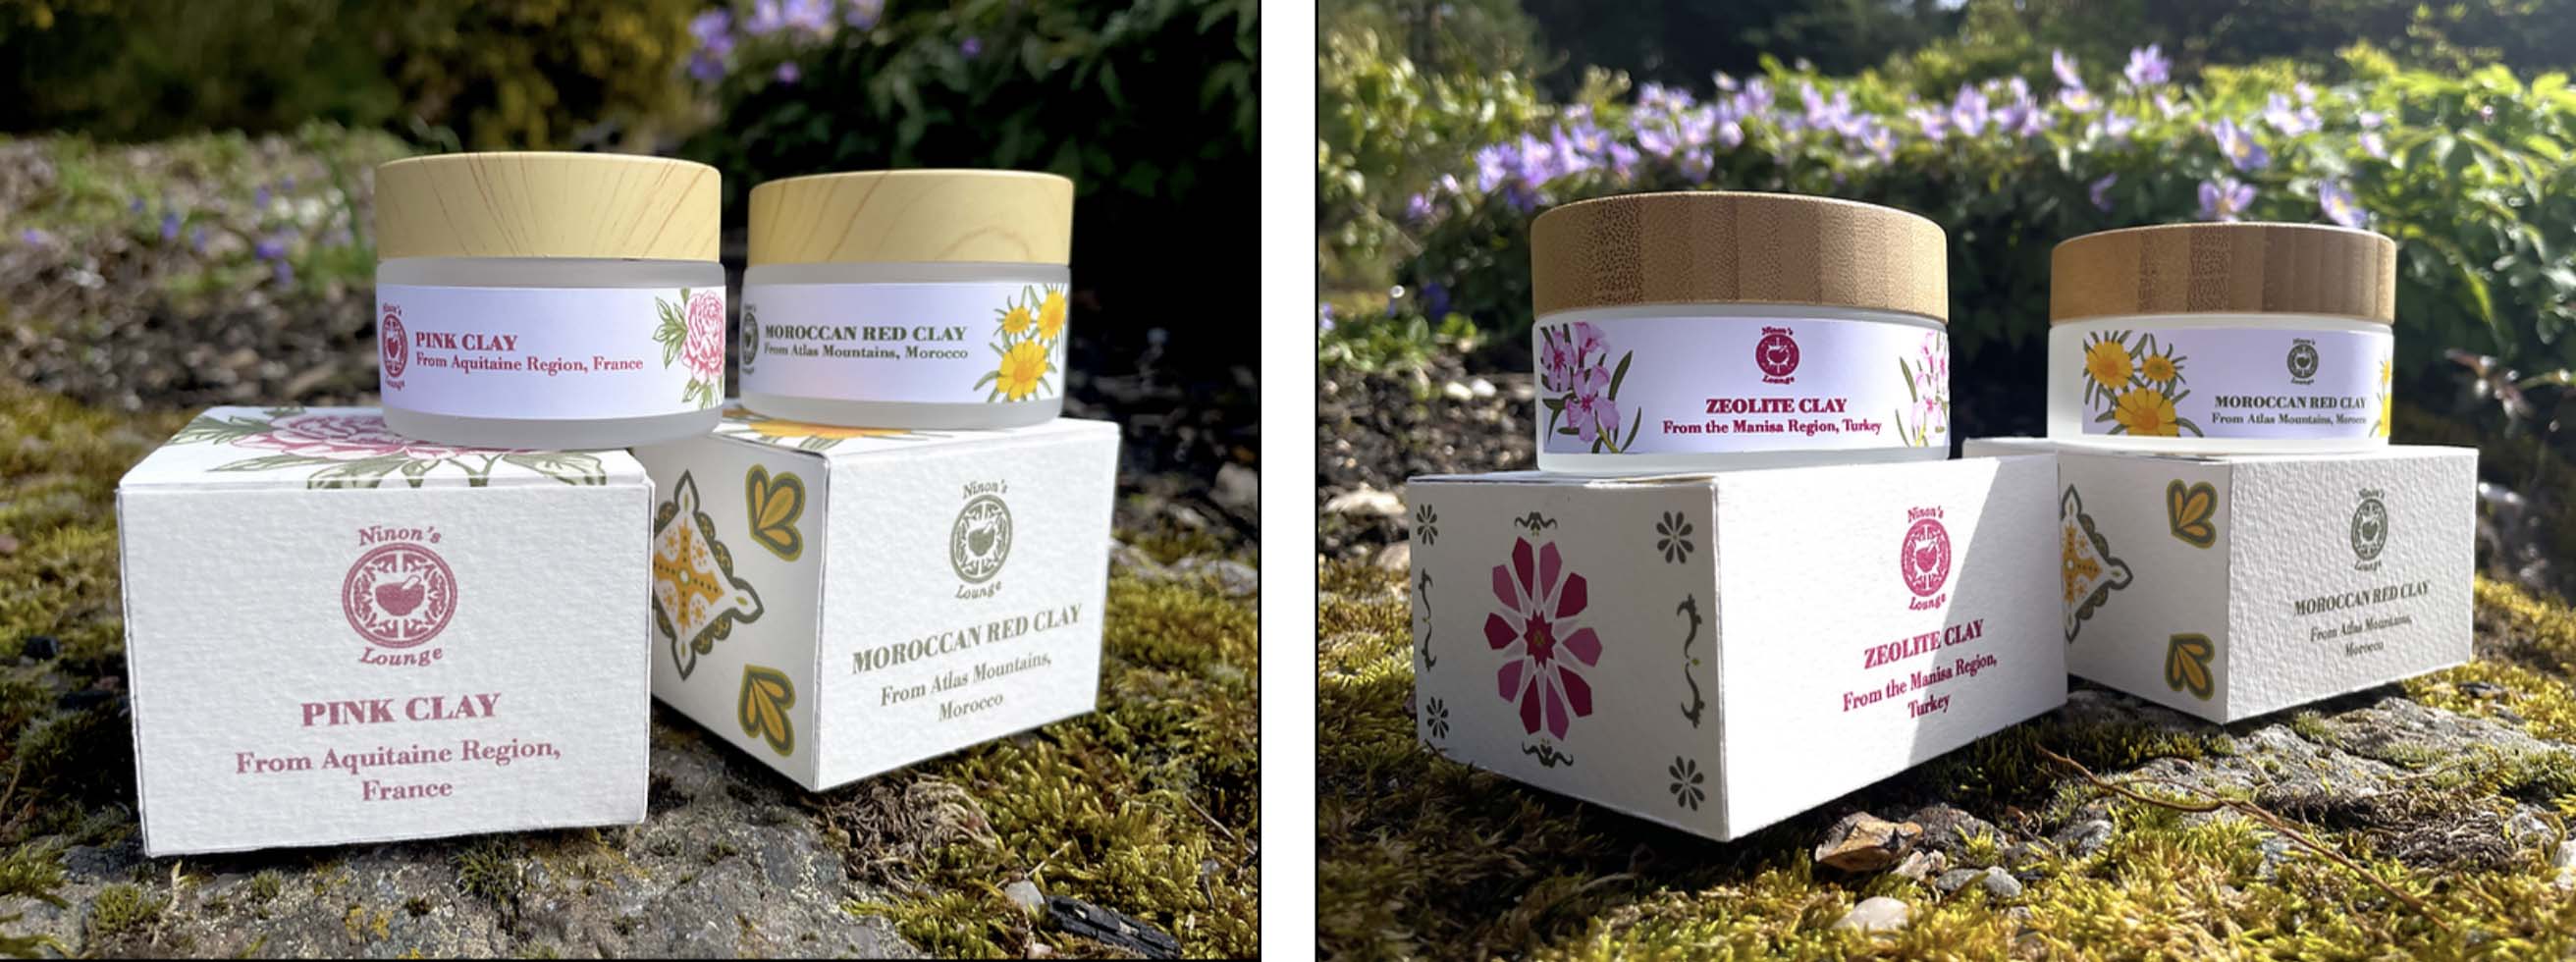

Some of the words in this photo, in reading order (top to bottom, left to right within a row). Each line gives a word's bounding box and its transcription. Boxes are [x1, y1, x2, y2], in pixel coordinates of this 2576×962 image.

[416, 332, 457, 349] PINK
[461, 333, 518, 351] CLAY
[765, 325, 857, 341] MOROCCAN
[863, 326, 907, 342] RED
[913, 326, 967, 342] CLAY
[764, 344, 788, 356] From
[792, 345, 818, 356] Atlas
[823, 346, 900, 360] Mountains,
[905, 347, 968, 359] Morocco
[416, 351, 448, 368] From
[452, 354, 522, 374] Aquitaine
[527, 356, 588, 376] Region,
[592, 355, 643, 371] France
[1706, 398, 1795, 414] ZEOLITE
[1798, 398, 1848, 413] CLAY
[2215, 396, 2306, 409] MOROCCAN
[2309, 396, 2337, 409] RED
[2339, 396, 2366, 409] CLAY
[1663, 420, 1702, 434] From
[1705, 419, 1729, 434] the
[1733, 419, 1784, 433] Manisa
[1788, 419, 1840, 437] Region,
[1842, 418, 1882, 436] Turkey
[2212, 412, 2244, 424] From
[2248, 412, 2275, 424] Atlas
[2278, 413, 2333, 425] Mountains,
[962, 479, 1008, 499] Ninon's
[1907, 506, 1944, 523] Ninon's
[358, 525, 442, 547] Ninon's
[954, 581, 1001, 600] Lounge
[2294, 591, 2371, 616] MOROCCAN
[2372, 585, 2398, 604] RED
[2400, 580, 2430, 599] CLAY
[1908, 593, 1947, 611] Lounge
[851, 624, 984, 674] MOROCCAN
[987, 615, 1029, 643] RED
[1033, 603, 1083, 632] CLAY
[1864, 631, 1941, 669] ZEOLITE
[1944, 618, 1984, 647] CLAY
[2310, 625, 2338, 642] From
[358, 647, 443, 668] Lounge
[881, 685, 926, 707] From
[930, 669, 968, 694] Atlas
[973, 652, 1052, 682] Mountains,
[1843, 690, 1883, 712] From
[1886, 679, 1907, 699] the
[1910, 666, 1953, 691] Manisa
[1956, 653, 1997, 676] Region,
[300, 698, 395, 727] PINK
[405, 693, 501, 722] CLAY
[939, 692, 1003, 722] Morocco
[1907, 694, 1950, 719] Turkey
[236, 751, 312, 774] From
[321, 744, 453, 775] Aquitaine
[461, 738, 562, 767] Region,
[362, 779, 453, 802] France
